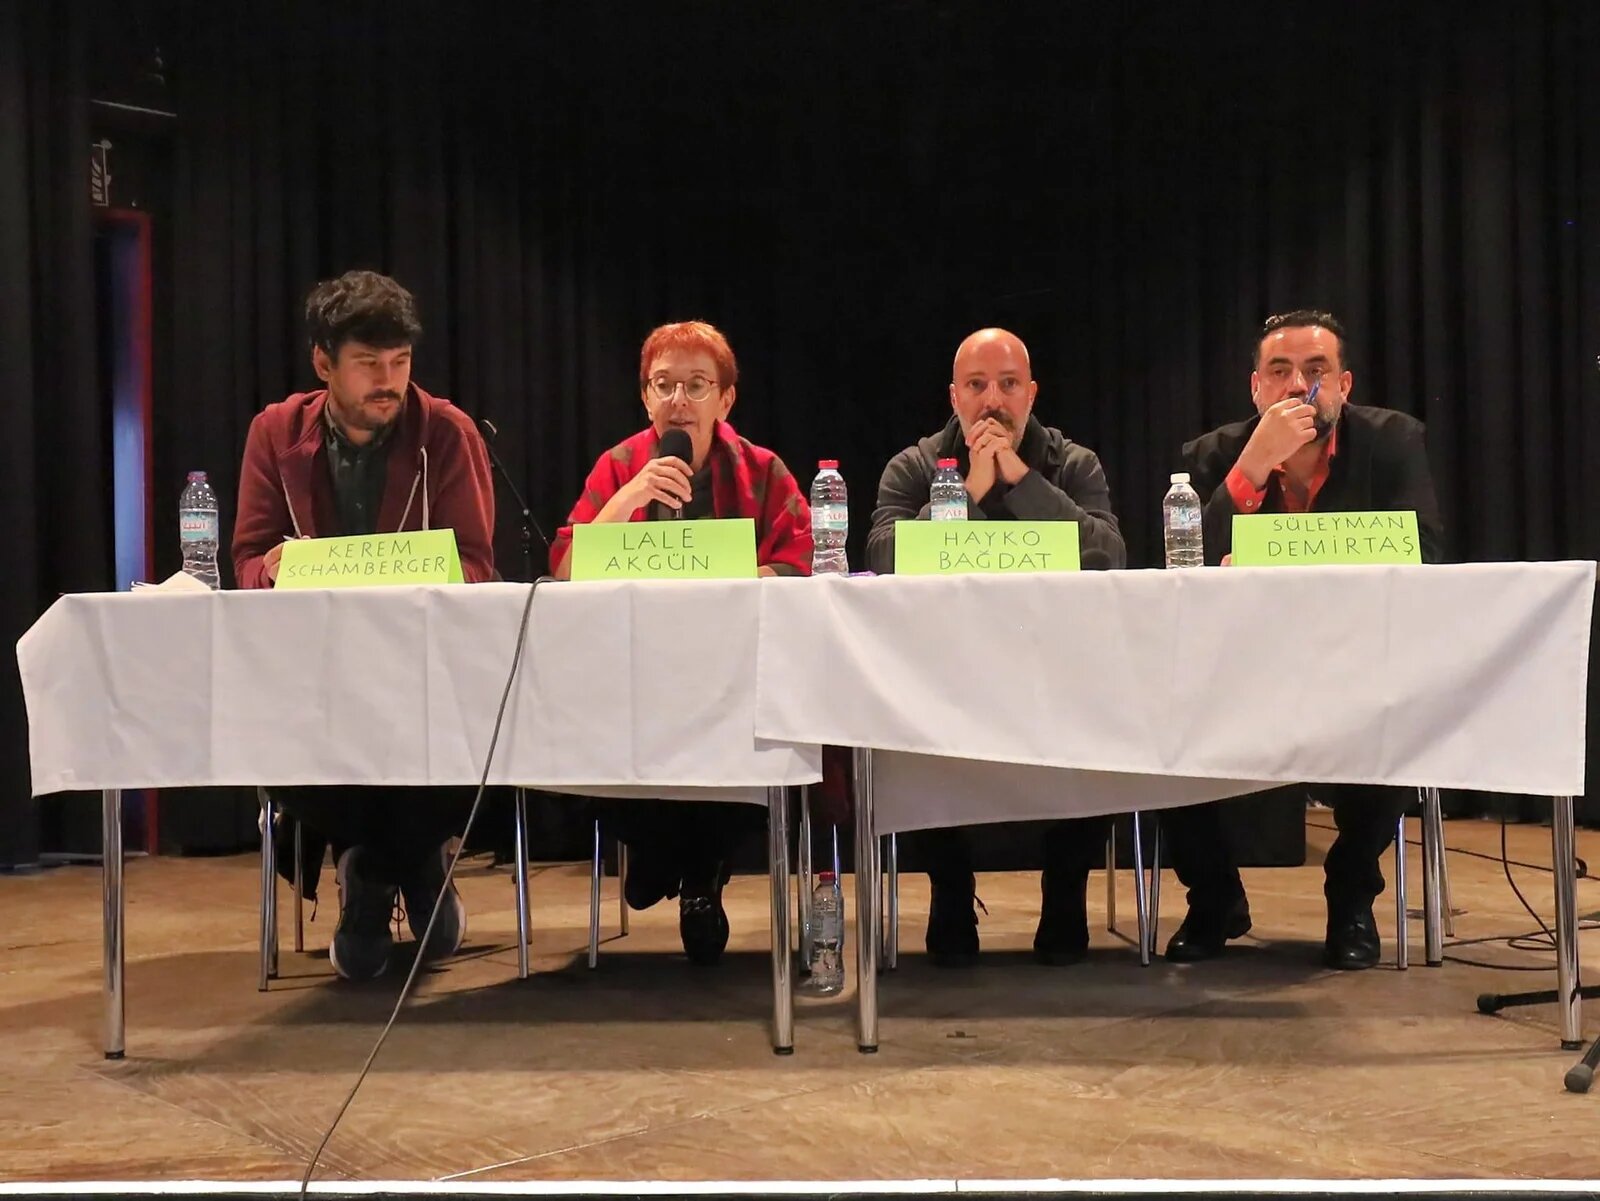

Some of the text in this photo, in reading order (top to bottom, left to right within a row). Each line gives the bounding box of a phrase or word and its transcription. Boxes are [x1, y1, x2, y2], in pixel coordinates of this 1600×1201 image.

[1273, 515, 1404, 532] SÜLEYMAN
[622, 527, 694, 551] LALE
[944, 530, 1041, 547] HAYKO
[1267, 535, 1415, 556] DEMİRTAŞ
[328, 539, 412, 559] KEREM
[286, 555, 446, 578] SCHAMBERGER
[604, 552, 710, 572] AKGÜN
